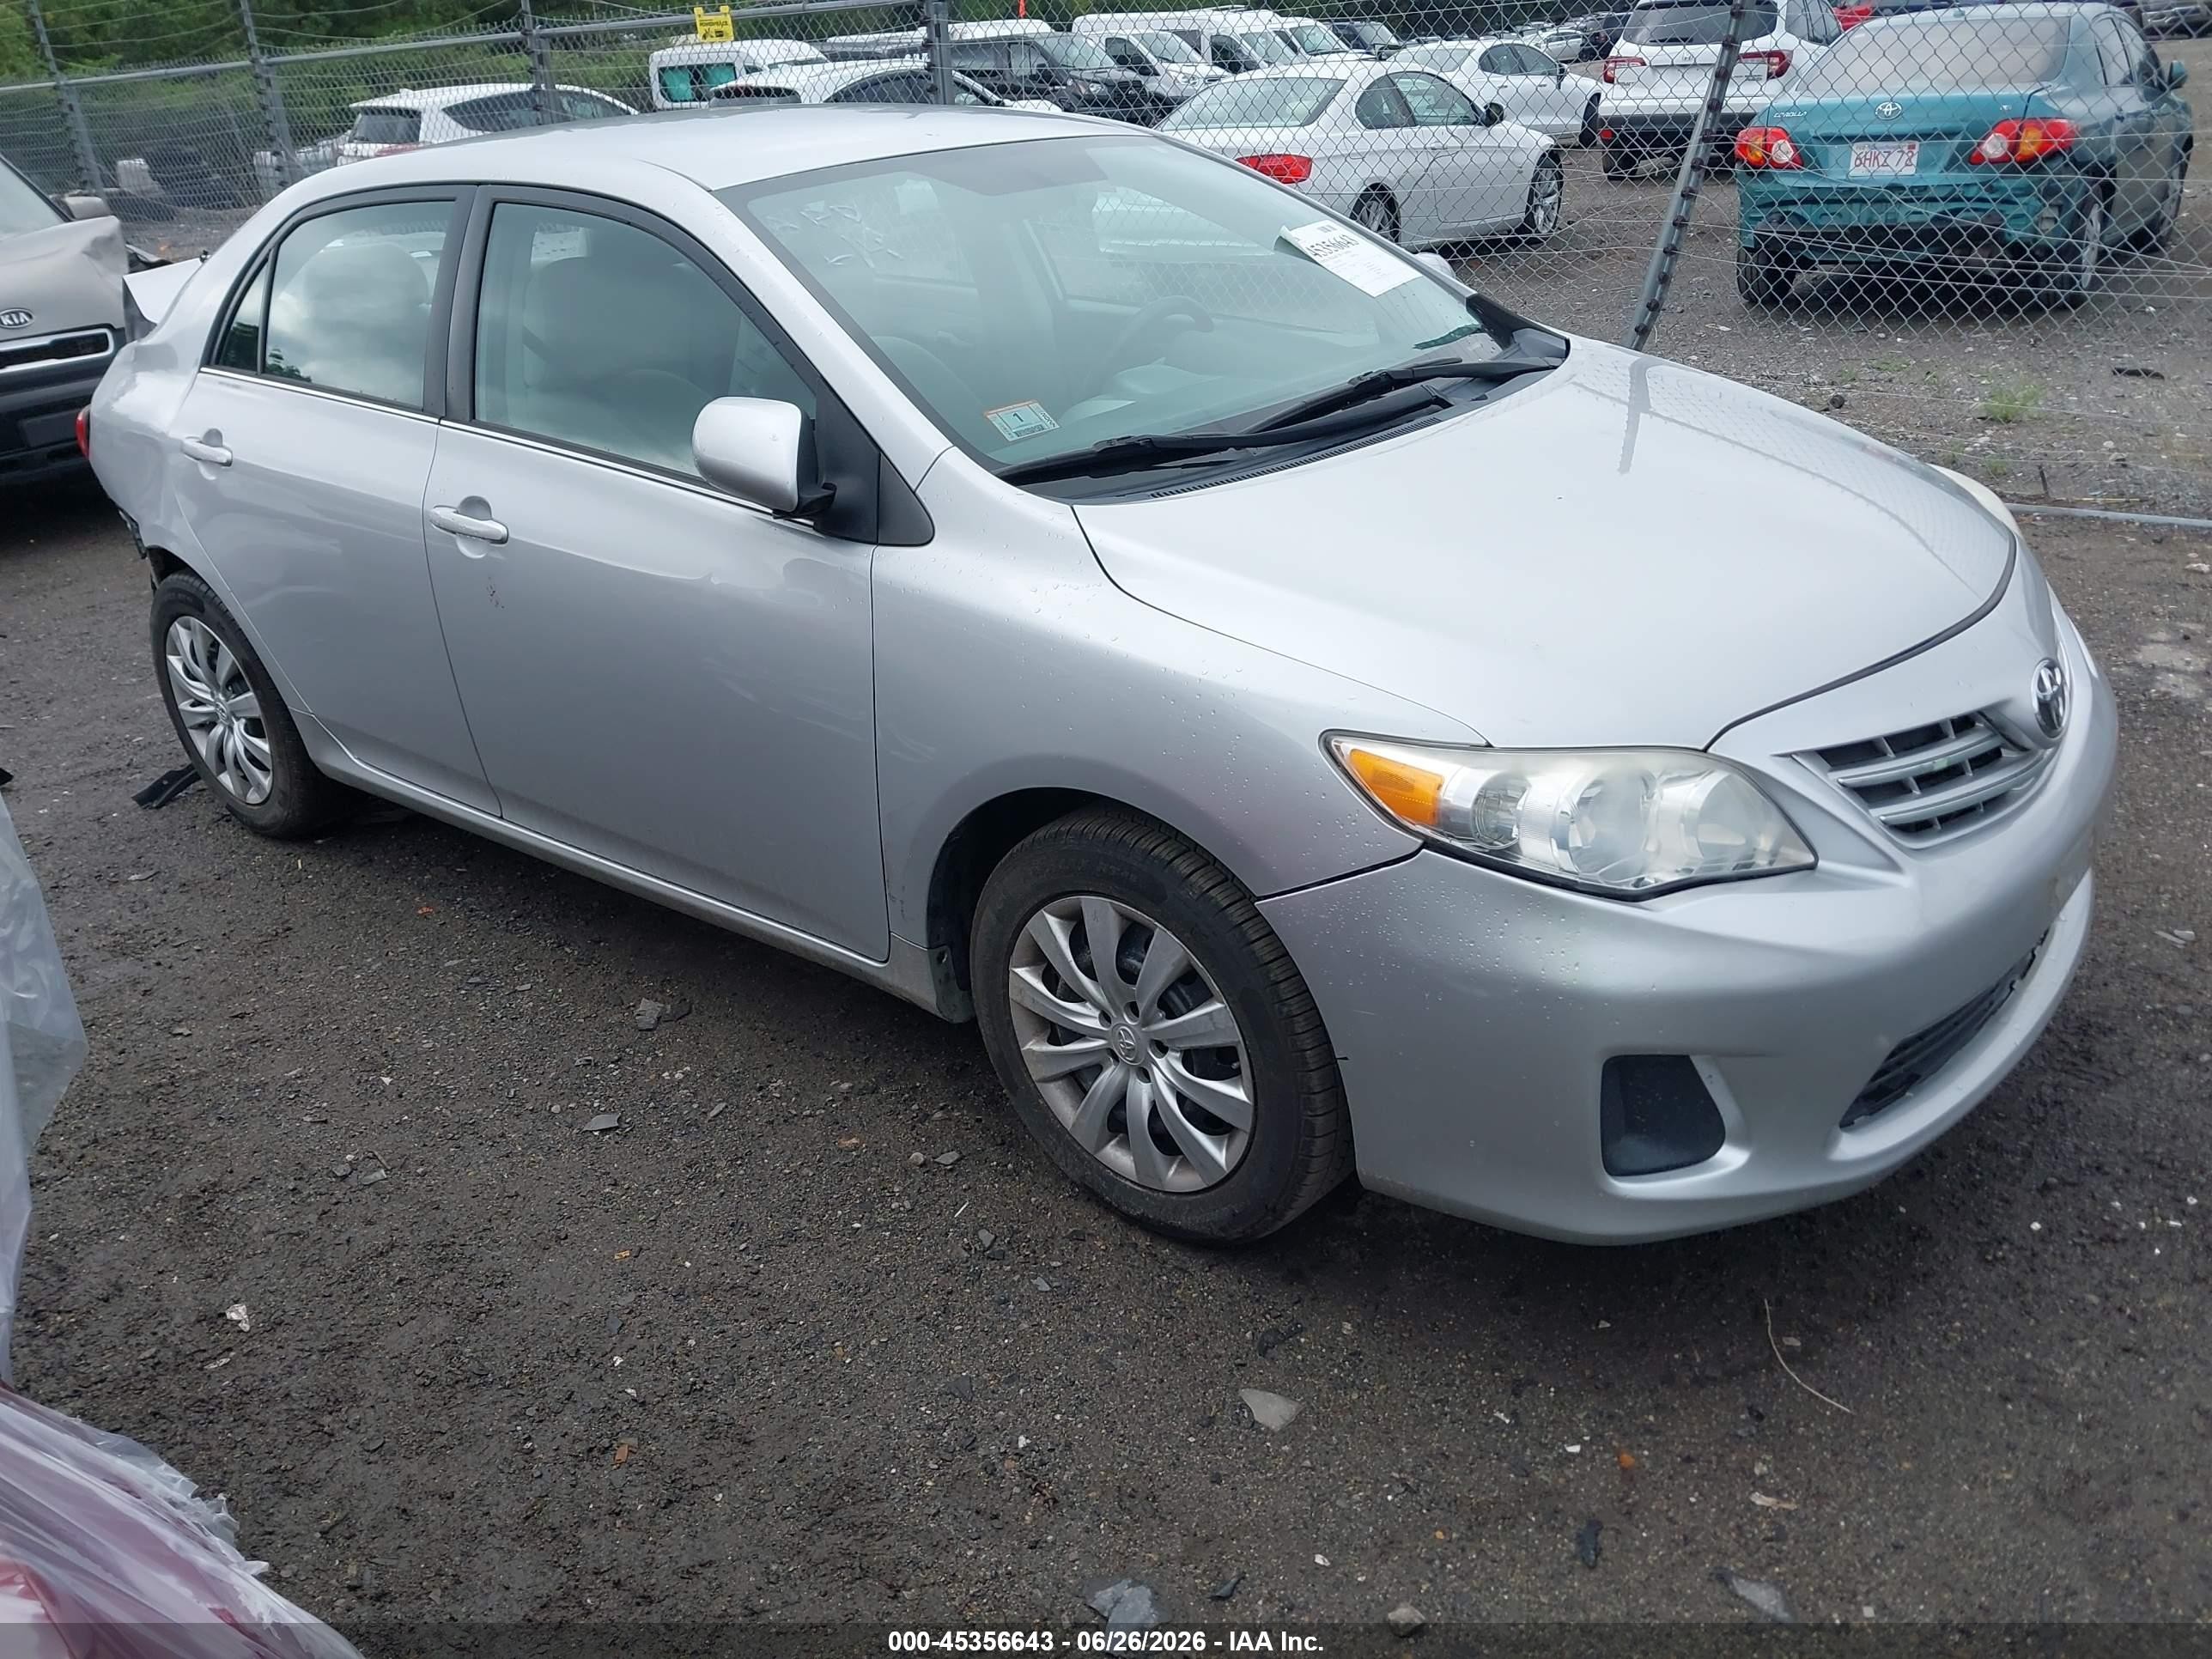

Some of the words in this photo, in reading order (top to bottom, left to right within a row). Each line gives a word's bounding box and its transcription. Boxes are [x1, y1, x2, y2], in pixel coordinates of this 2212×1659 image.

[1854, 150, 1891, 167] 6HKZ
[0, 312, 29, 325] KIA
[1012, 412, 1024, 422] 1
